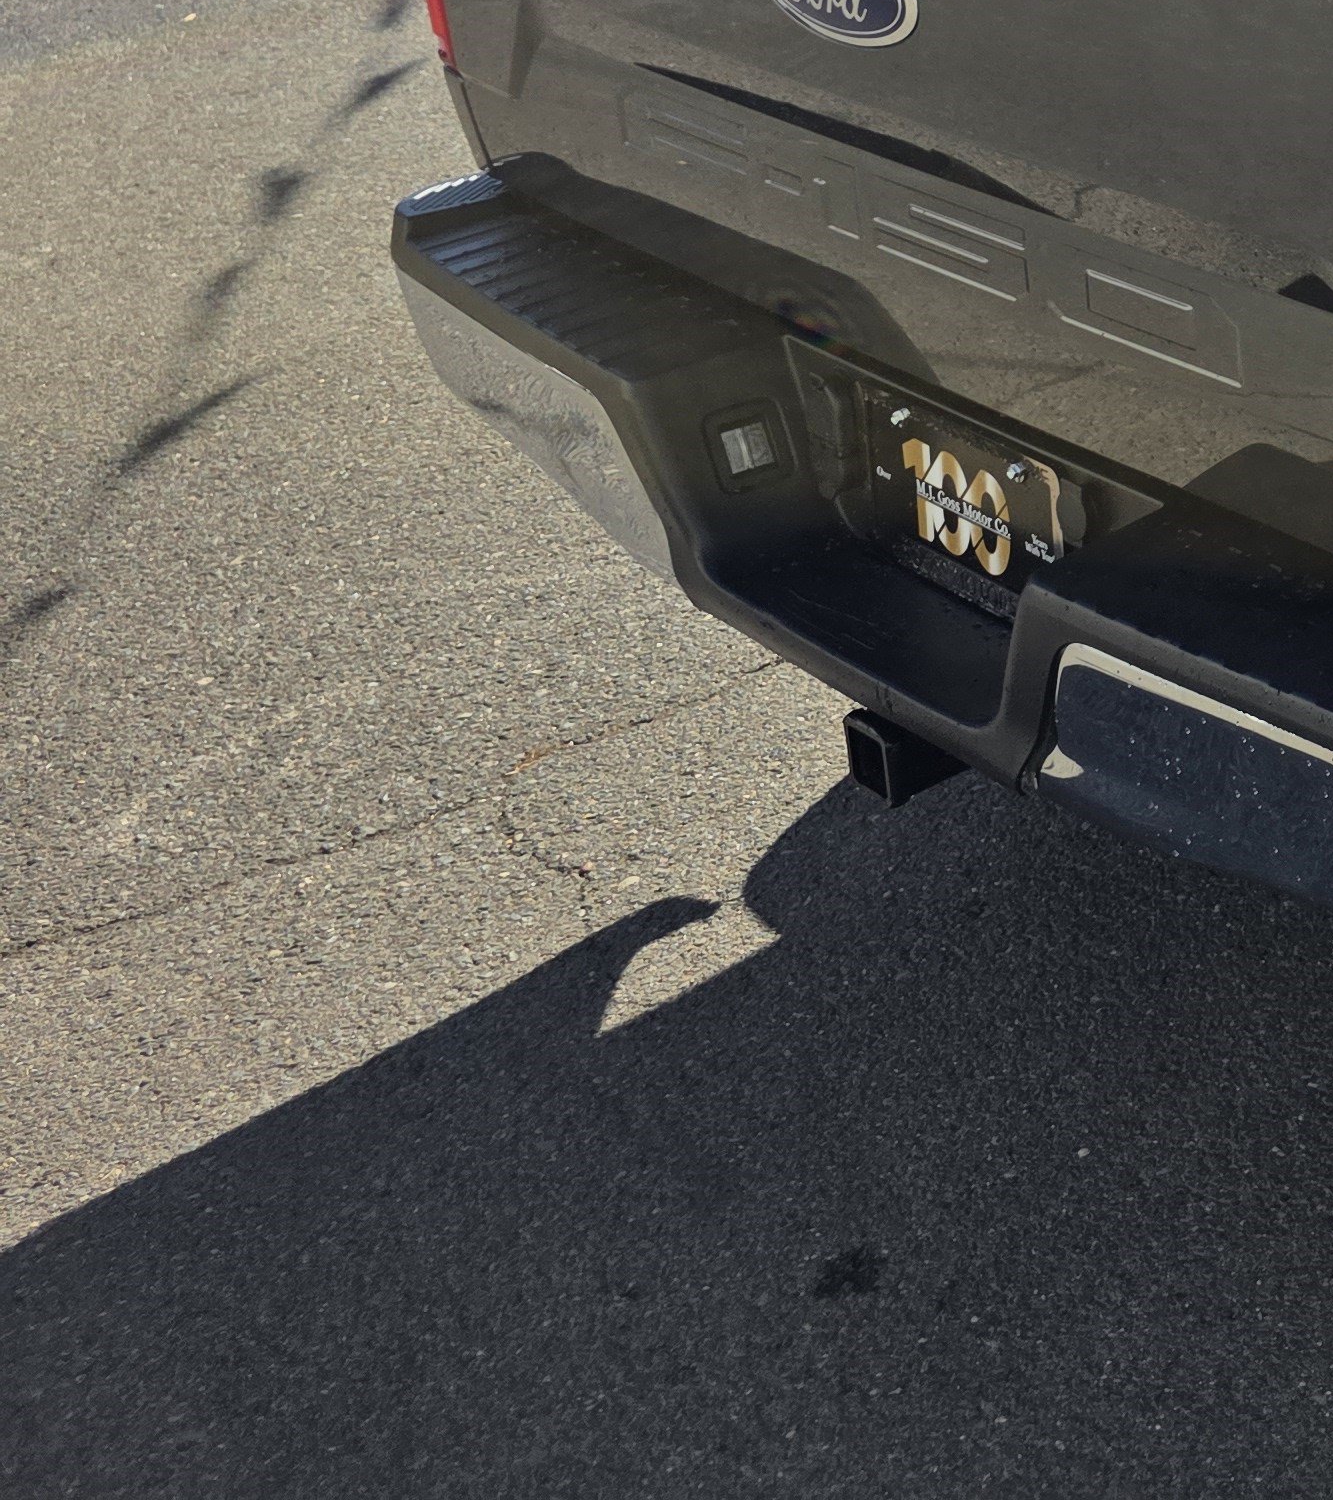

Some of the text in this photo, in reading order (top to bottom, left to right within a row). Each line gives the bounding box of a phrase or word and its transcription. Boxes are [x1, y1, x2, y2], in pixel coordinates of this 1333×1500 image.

[902, 438, 1011, 576] 100
[937, 490, 961, 513] Goss
[962, 501, 993, 529] Motor
[994, 517, 1012, 538] Co.
